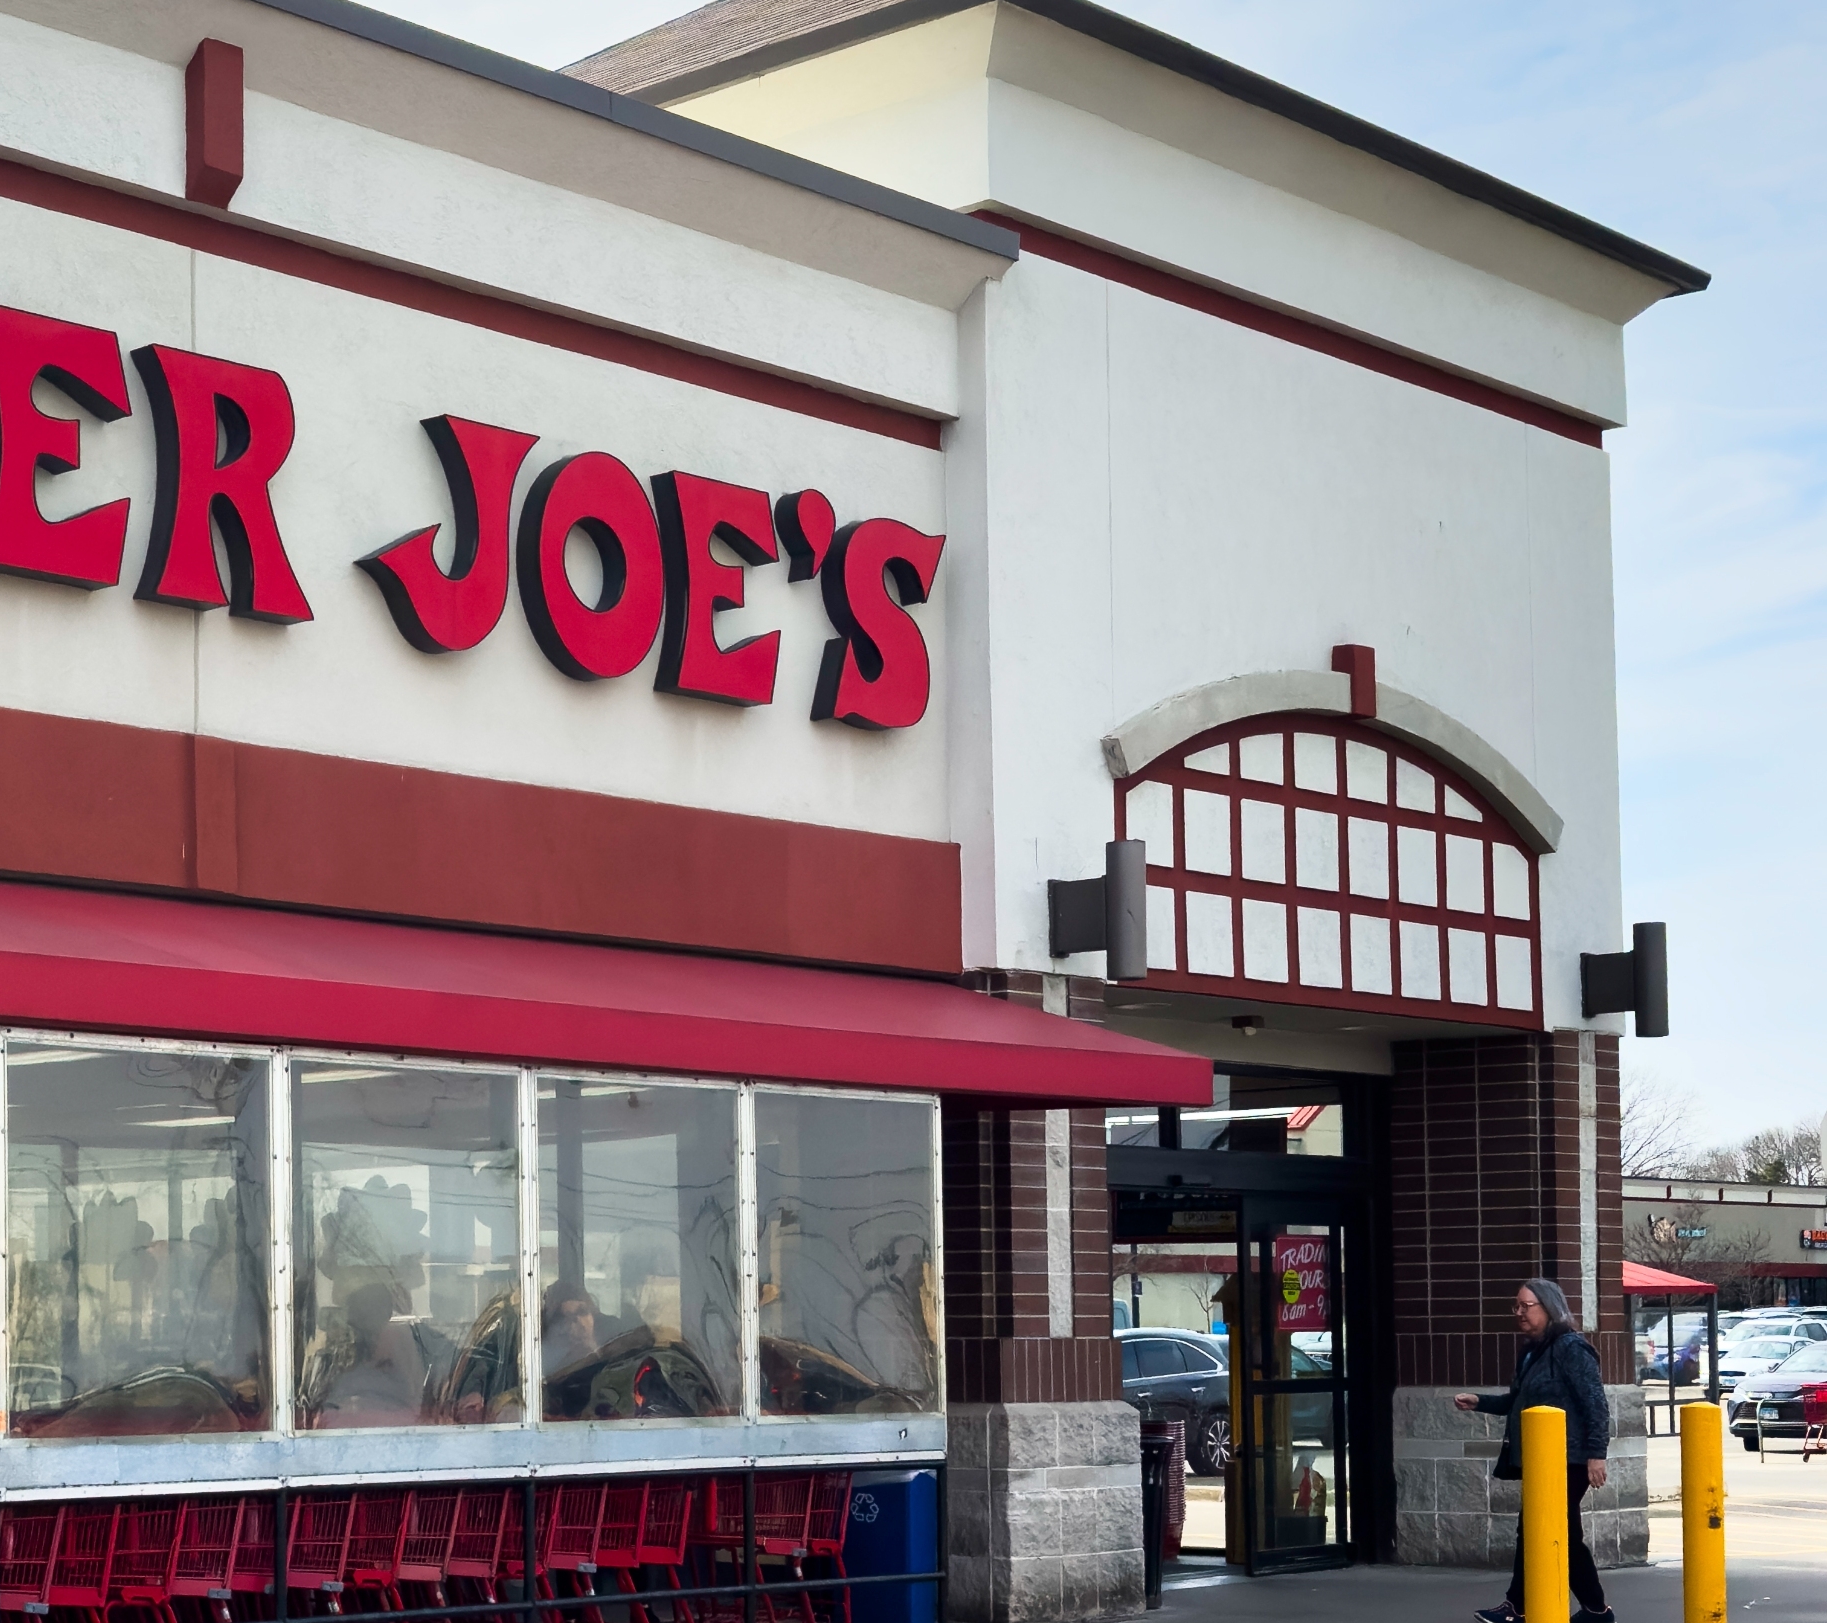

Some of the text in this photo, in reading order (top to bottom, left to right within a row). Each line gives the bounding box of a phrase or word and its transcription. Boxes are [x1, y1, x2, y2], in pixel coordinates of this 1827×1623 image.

[354, 414, 945, 730] JOE'S
[1280, 1243, 1329, 1272] TRADIN
[1297, 1269, 1328, 1290] OUR
